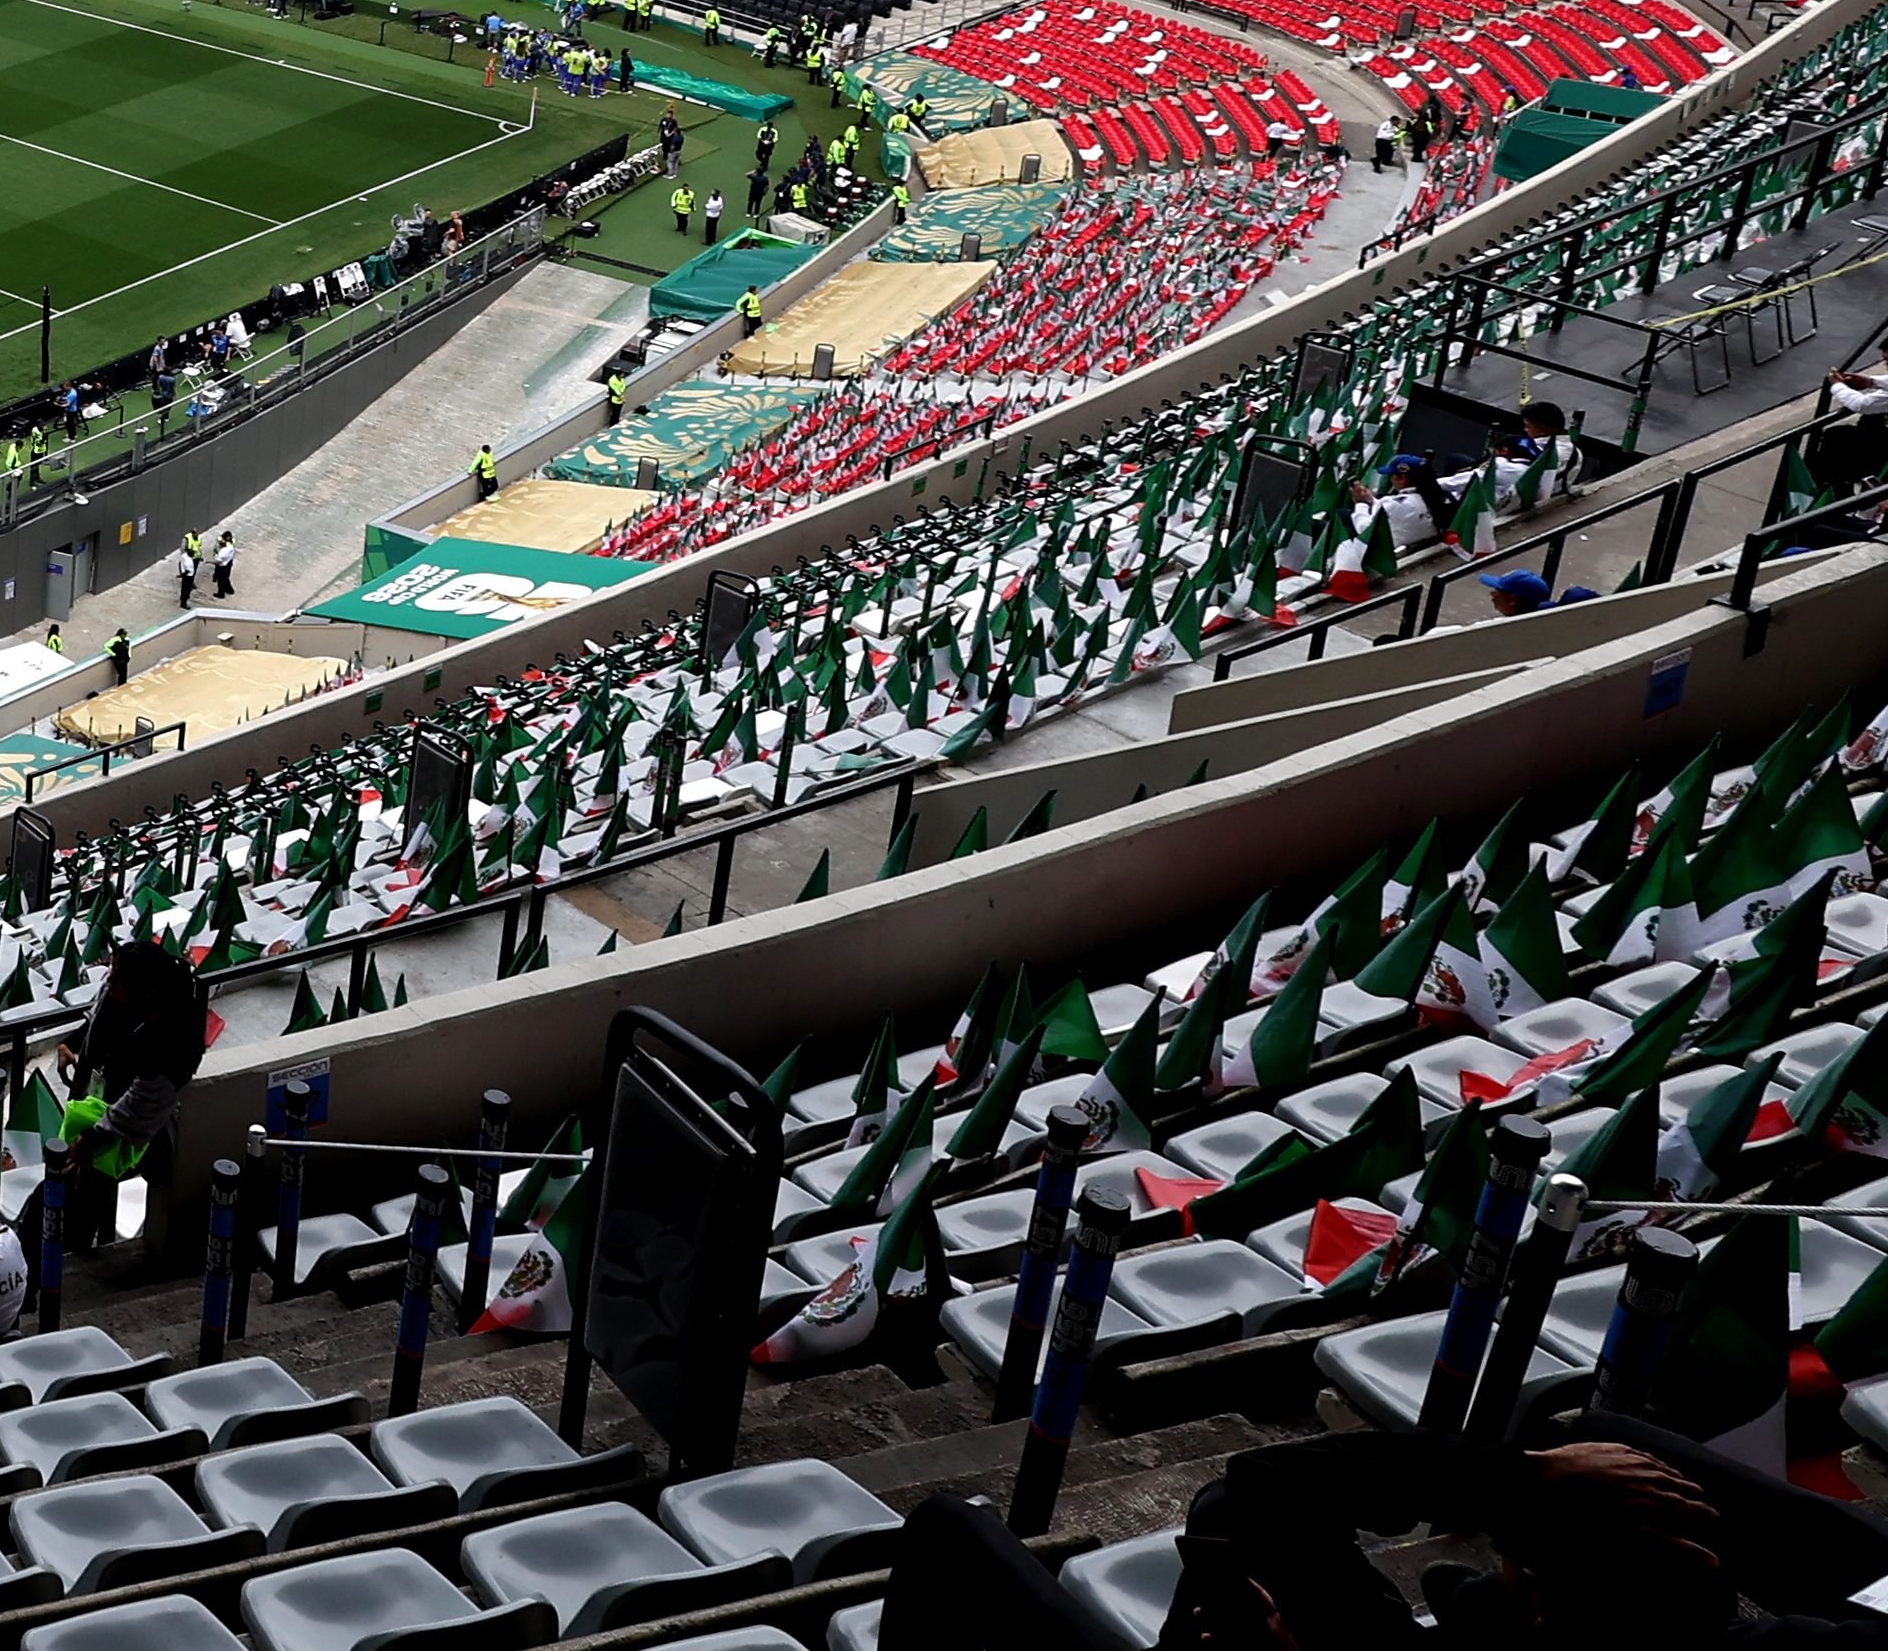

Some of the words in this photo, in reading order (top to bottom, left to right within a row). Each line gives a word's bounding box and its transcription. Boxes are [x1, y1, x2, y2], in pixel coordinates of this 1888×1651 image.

[361, 563, 440, 602] 2026
[411, 569, 459, 594] WORLD
[437, 582, 479, 602] FIFA
[387, 590, 416, 605] CUP
